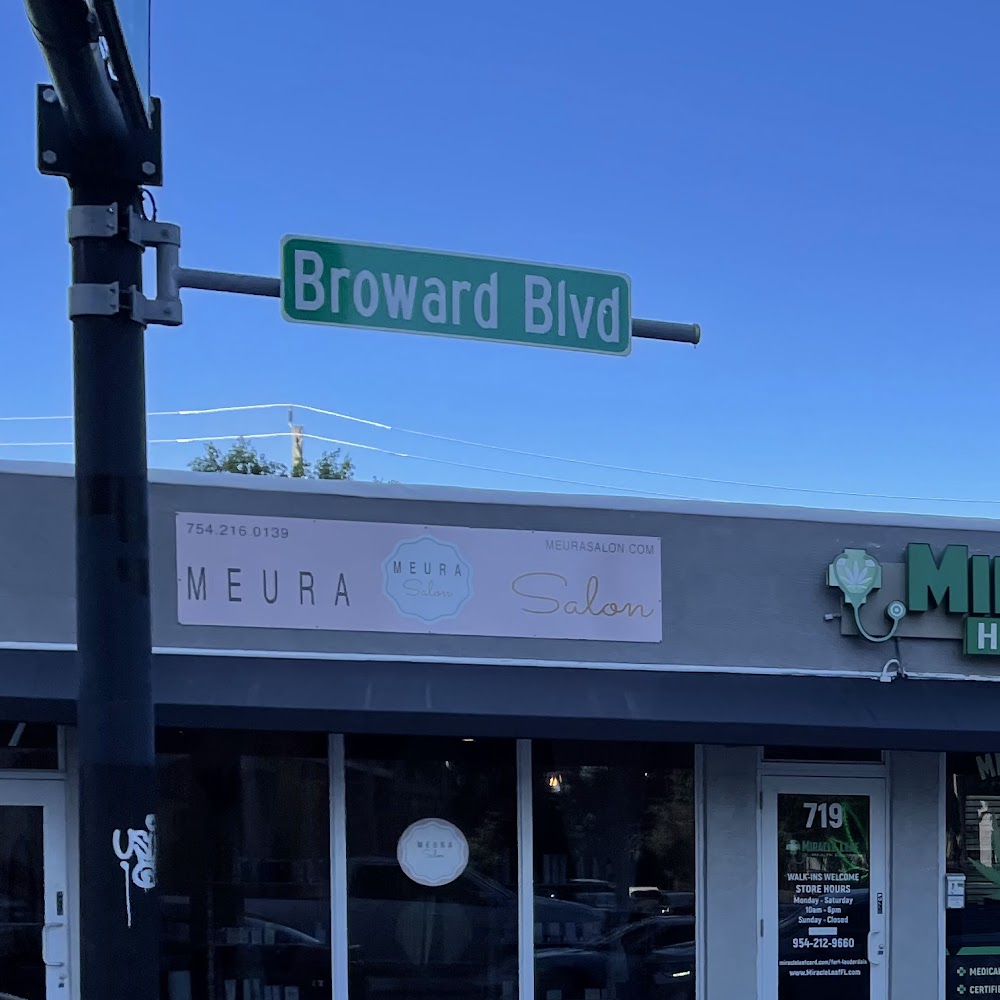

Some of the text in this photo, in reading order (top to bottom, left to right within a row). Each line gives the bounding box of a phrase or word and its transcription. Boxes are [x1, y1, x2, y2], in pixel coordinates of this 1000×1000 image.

[294, 249, 620, 343] Broward Blvd
[186, 522, 289, 539] 754.216.0139
[545, 539, 654, 555] MEURASALON.COM
[393, 560, 462, 577] MEURA
[187, 566, 350, 607] MEURA
[402, 578, 454, 598] Salon
[512, 572, 655, 618] Salon
[803, 802, 844, 829] 719
[787, 872, 859, 881] WALK-INS WELCOME
[795, 884, 851, 894] STORE HOURS
[793, 895, 819, 906] Monday
[824, 896, 853, 905] Saturday
[805, 906, 822, 914] 10am
[798, 915, 822, 925] Sunday
[827, 915, 849, 924] Closed
